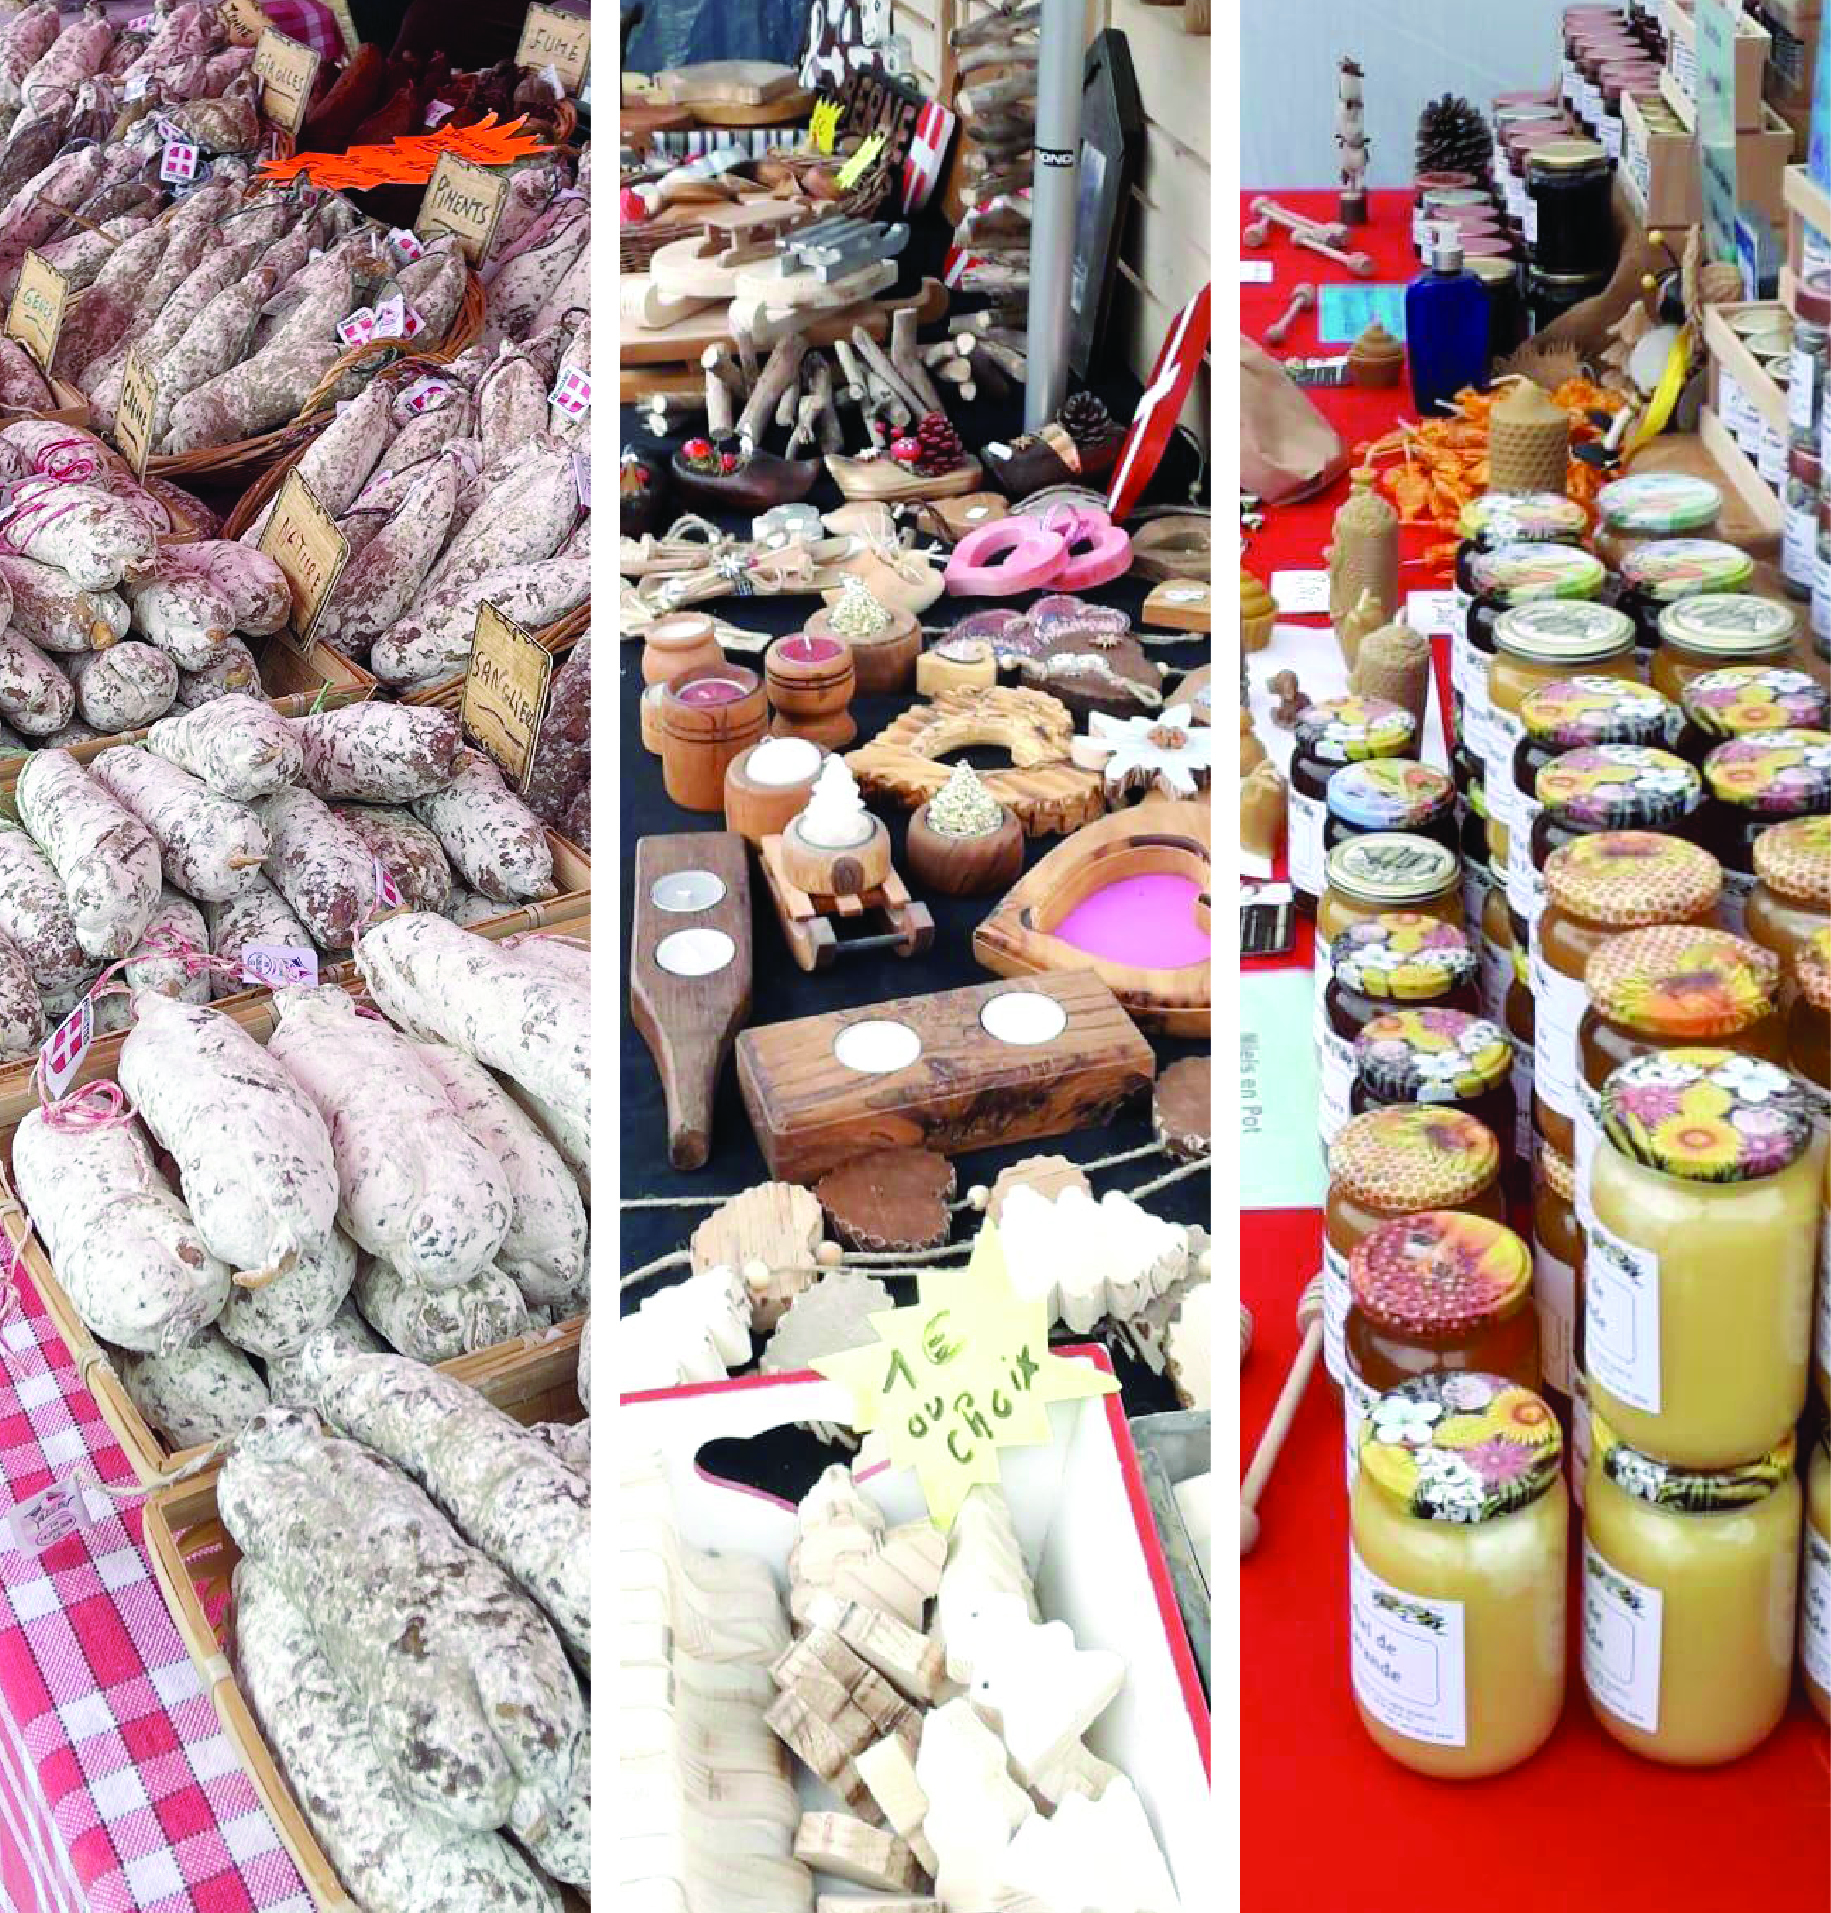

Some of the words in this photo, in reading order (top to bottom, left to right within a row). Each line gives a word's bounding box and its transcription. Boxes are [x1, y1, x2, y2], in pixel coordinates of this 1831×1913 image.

[430, 174, 489, 225] PIMENTS
[472, 651, 534, 728] SANGLIER
[1240, 1078, 1257, 1099] en
[1240, 1105, 1262, 1135] Pot
